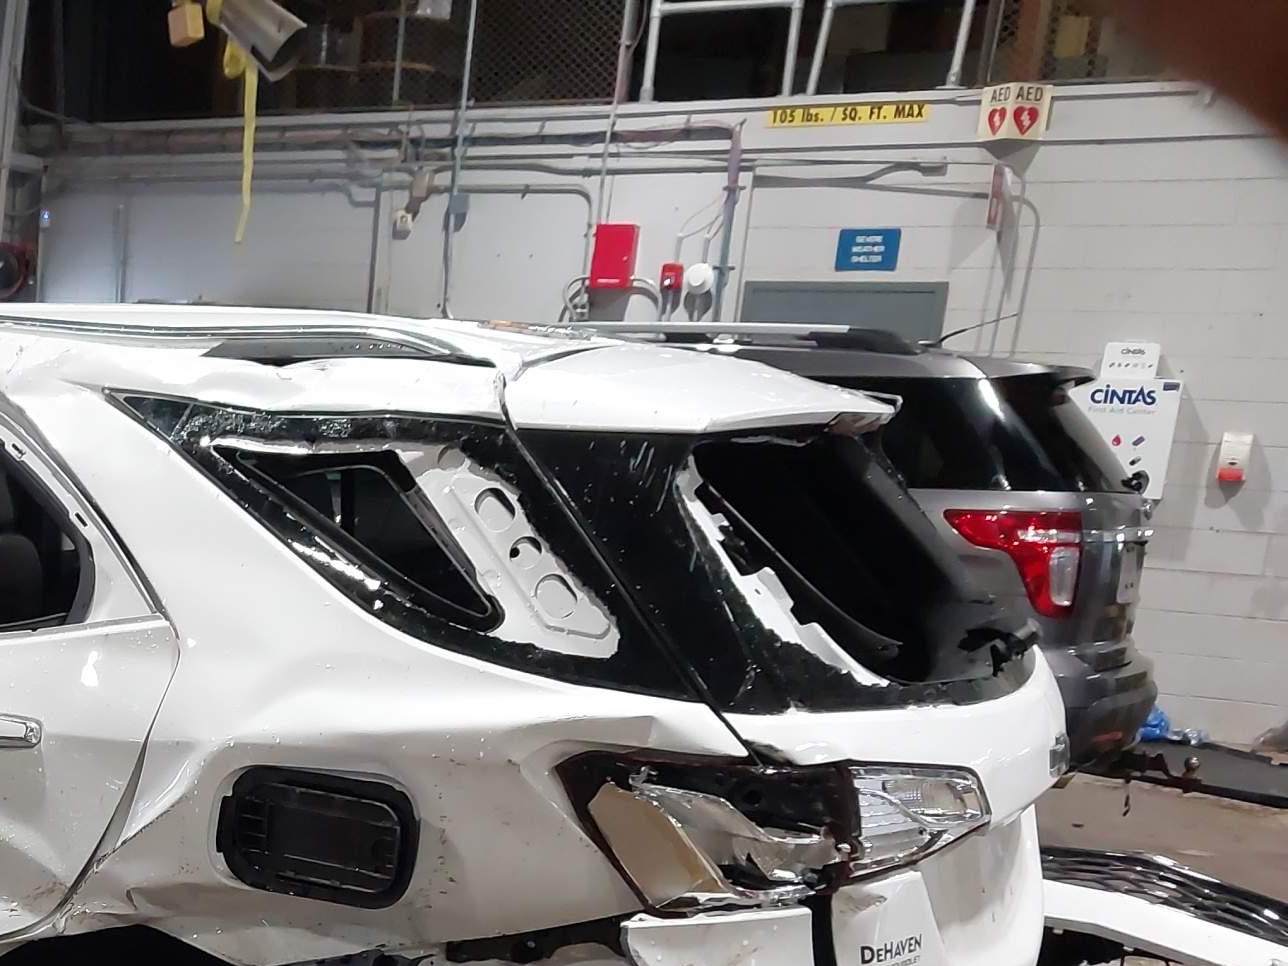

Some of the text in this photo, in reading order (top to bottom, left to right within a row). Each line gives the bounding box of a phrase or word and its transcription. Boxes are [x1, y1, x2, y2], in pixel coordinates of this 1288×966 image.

[990, 88, 1011, 103] AED
[1016, 87, 1044, 102] AED
[772, 110, 796, 124] 105
[801, 107, 824, 122] lbs.
[841, 106, 863, 121] SQ.
[868, 105, 887, 120] FT.
[893, 103, 926, 119] MAX
